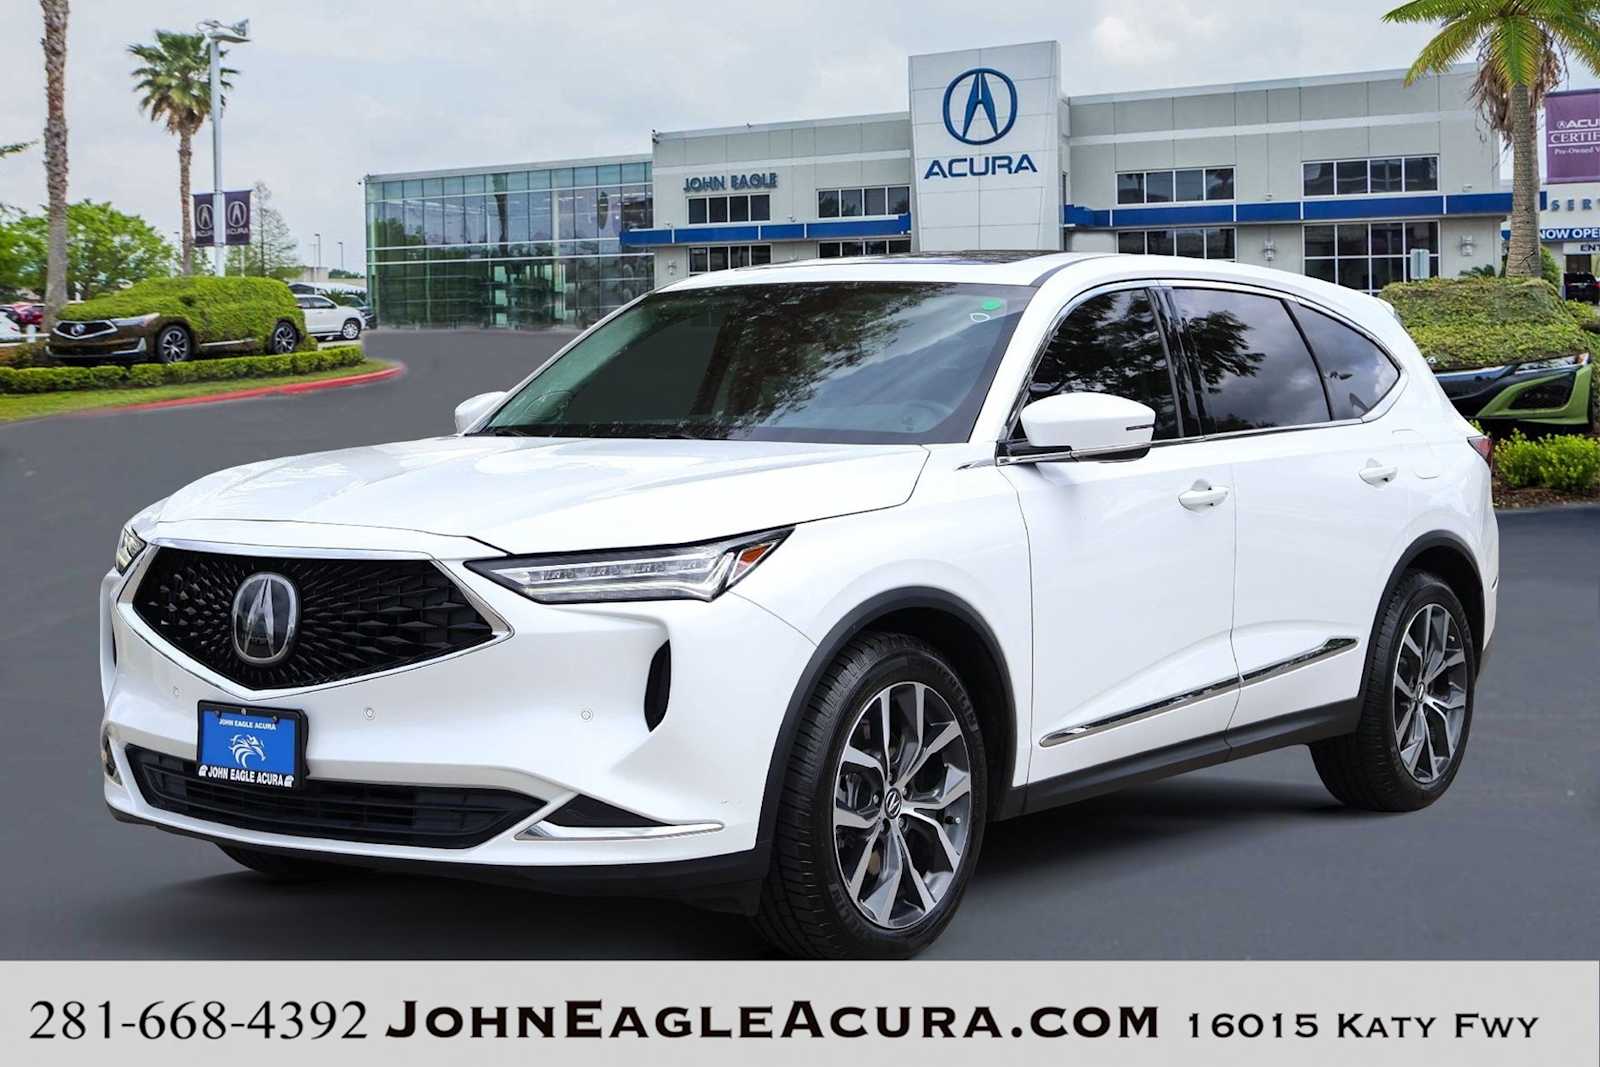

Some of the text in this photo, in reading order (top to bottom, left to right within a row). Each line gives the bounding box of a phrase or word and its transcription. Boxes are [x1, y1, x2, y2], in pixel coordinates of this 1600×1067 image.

[1567, 118, 1600, 128] ACU
[924, 154, 1038, 179] ACURA
[683, 172, 777, 192] JOHN EAGLE
[1551, 198, 1600, 211] SER
[1572, 228, 1600, 239] OPE
[219, 718, 276, 730] JOHN EAGLE ACURA
[208, 766, 283, 786] JOHN EAGLE ACURA
